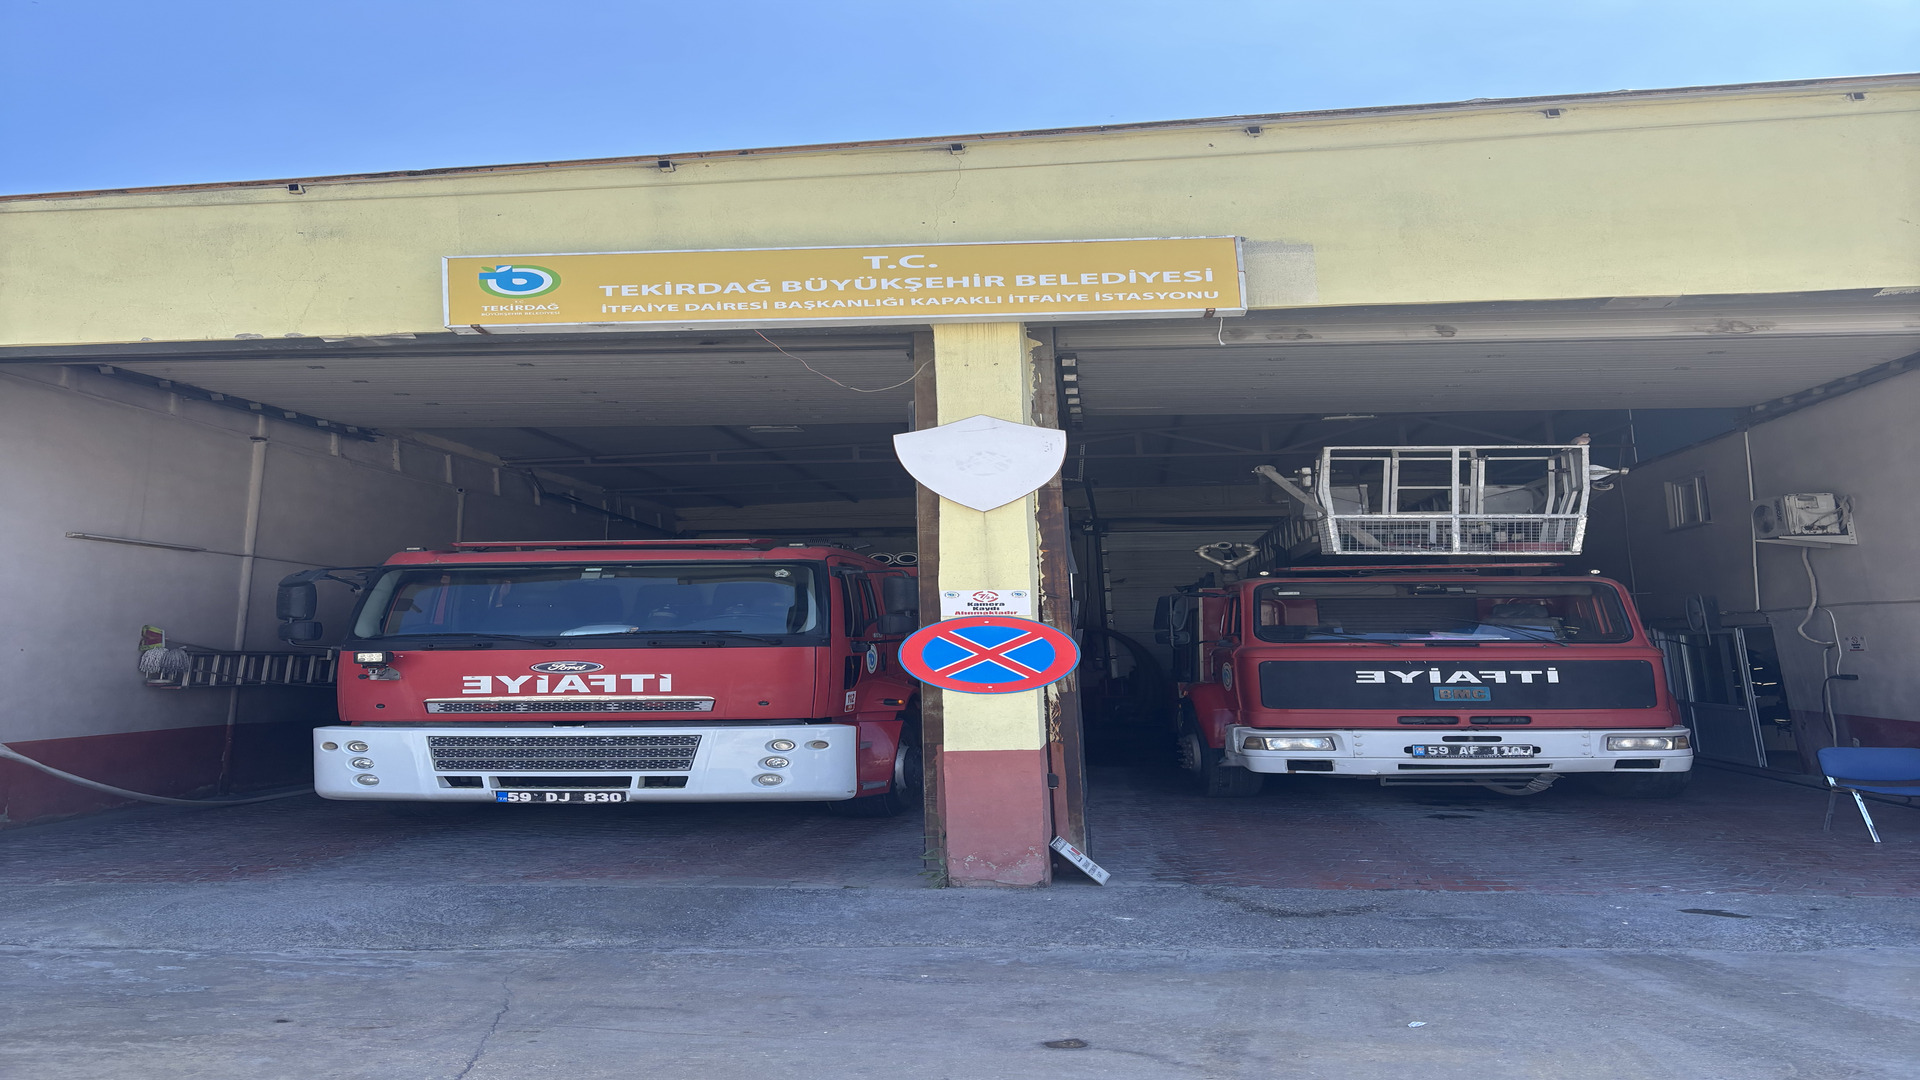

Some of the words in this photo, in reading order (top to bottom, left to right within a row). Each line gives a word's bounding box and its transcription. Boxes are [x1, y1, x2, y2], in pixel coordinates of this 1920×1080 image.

[863, 254, 938, 269] T.C.
[599, 278, 771, 296] TEKİRDAĞ
[782, 273, 1005, 292] BÜYÜKŞEHİR
[1015, 268, 1213, 287] BELEDİYESİ
[602, 303, 679, 313] İTFAİYE
[685, 300, 767, 312] DAİRESİ
[774, 297, 904, 310] BAŞKANLIĞI
[911, 296, 1002, 306] KAPAKLI
[1009, 293, 1089, 303] İTFAİYE
[1095, 290, 1219, 301] İSTASYONU
[481, 303, 560, 311] TEKİRDAĞ
[547, 662, 587, 672] Ford
[1439, 689, 1486, 699] BMC
[1428, 746, 1449, 755] 59
[1459, 746, 1479, 755] AF
[507, 792, 532, 802] 59
[545, 793, 571, 802] DJ
[584, 793, 622, 802] 830
